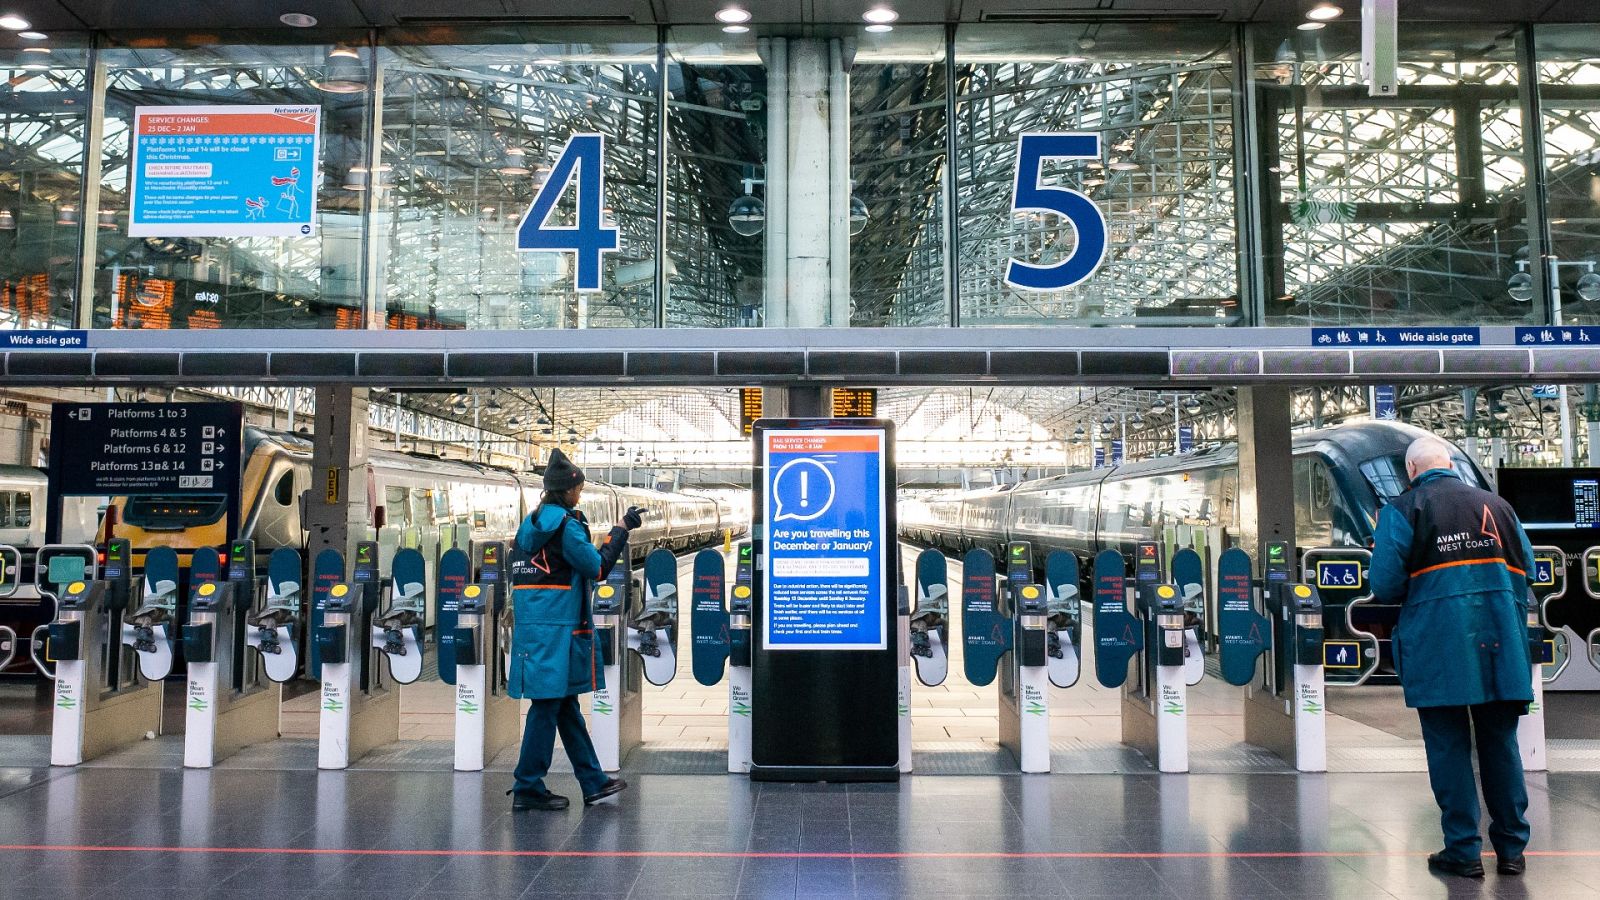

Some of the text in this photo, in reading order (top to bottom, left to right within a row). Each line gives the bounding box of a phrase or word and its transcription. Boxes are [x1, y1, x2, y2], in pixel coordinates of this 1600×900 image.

[515, 132, 621, 293] 4
[1004, 132, 1107, 293] 5
[10, 336, 81, 346] Wide aisle gate
[1400, 333, 1474, 343] Wide aisle gate
[108, 408, 187, 418] Platforms 1 to 3
[110, 428, 186, 438] Platforms 4 & 5
[104, 444, 186, 454] Platforms 6 & 12
[91, 462, 138, 471] Platforms
[162, 462, 170, 471] &
[172, 462, 185, 471] 14
[774, 529, 870, 540] Are you travelling this
[1436, 532, 1470, 544] AVANTI
[774, 542, 820, 550] December
[832, 542, 872, 552] January?
[1438, 538, 1495, 552] WEST COAST
